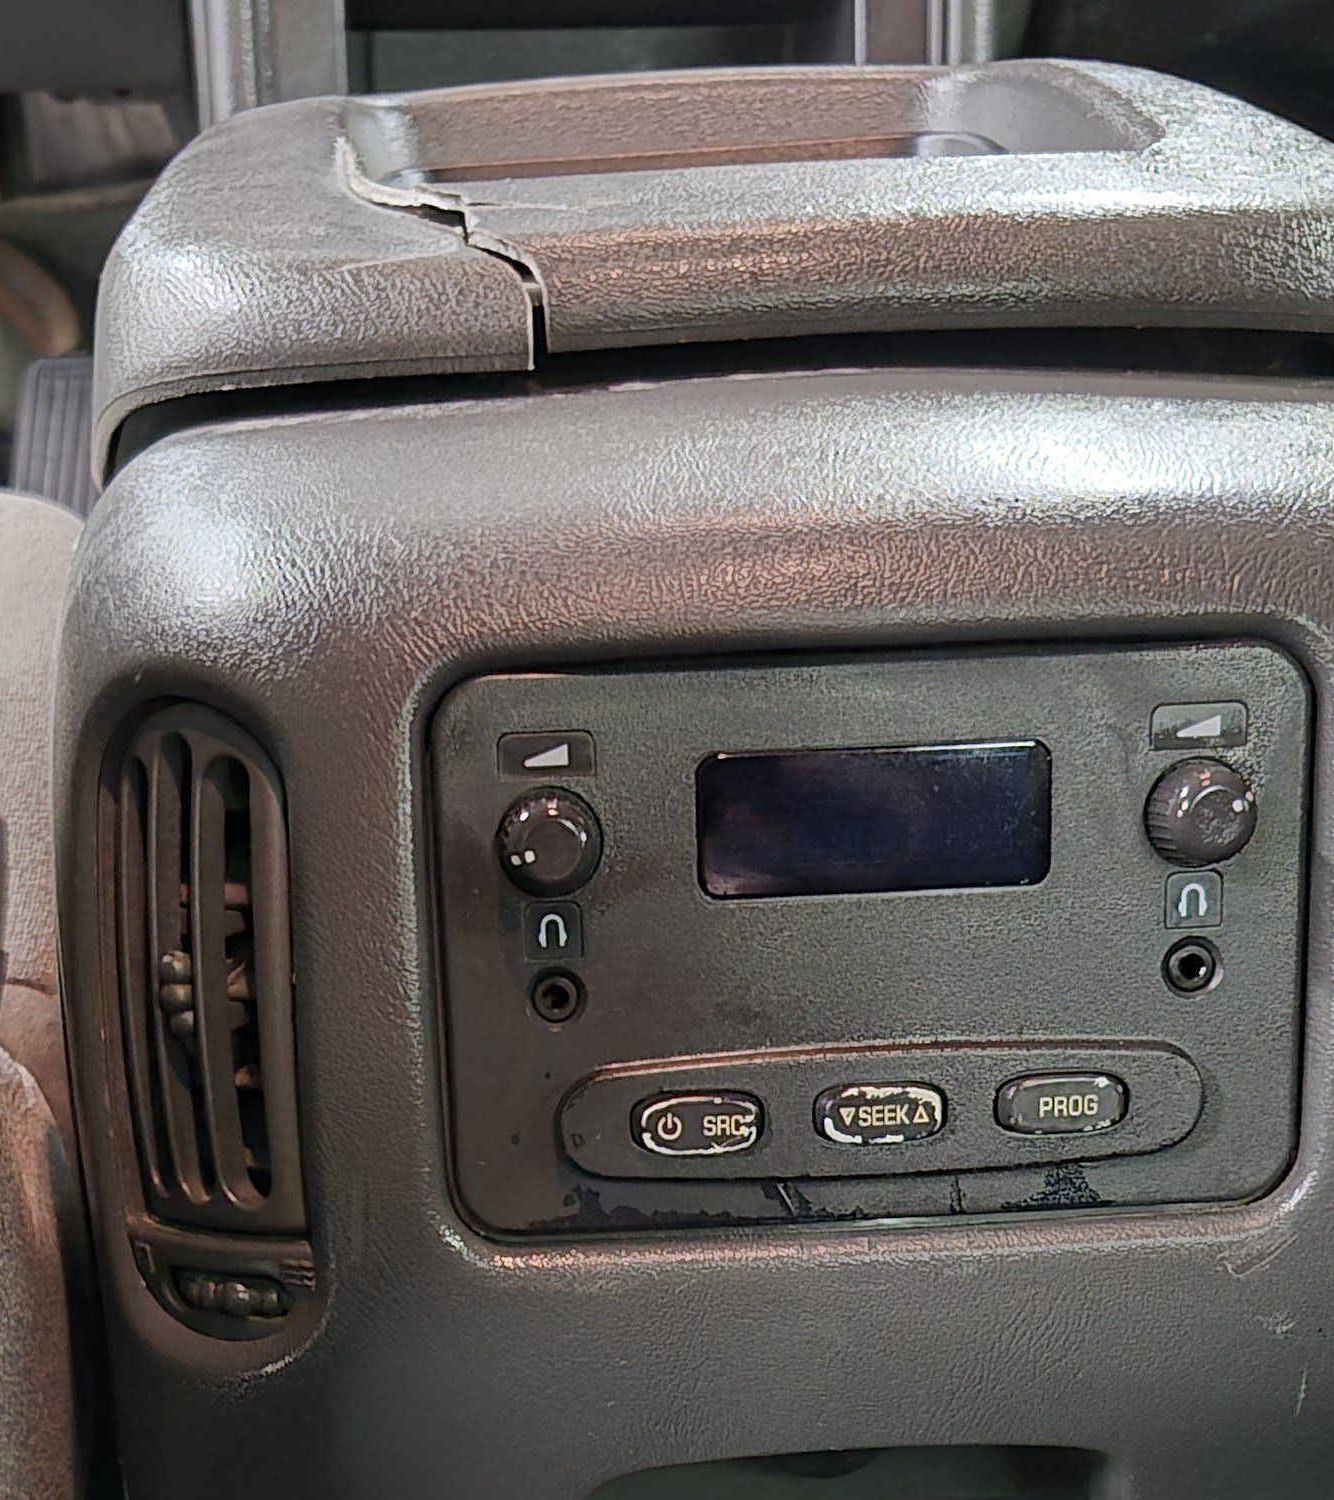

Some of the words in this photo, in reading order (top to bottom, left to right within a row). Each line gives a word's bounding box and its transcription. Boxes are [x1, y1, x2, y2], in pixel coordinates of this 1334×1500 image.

[858, 1103, 911, 1127] SEEK
[1038, 1094, 1099, 1118] PROG
[702, 1114, 748, 1137] SRC
